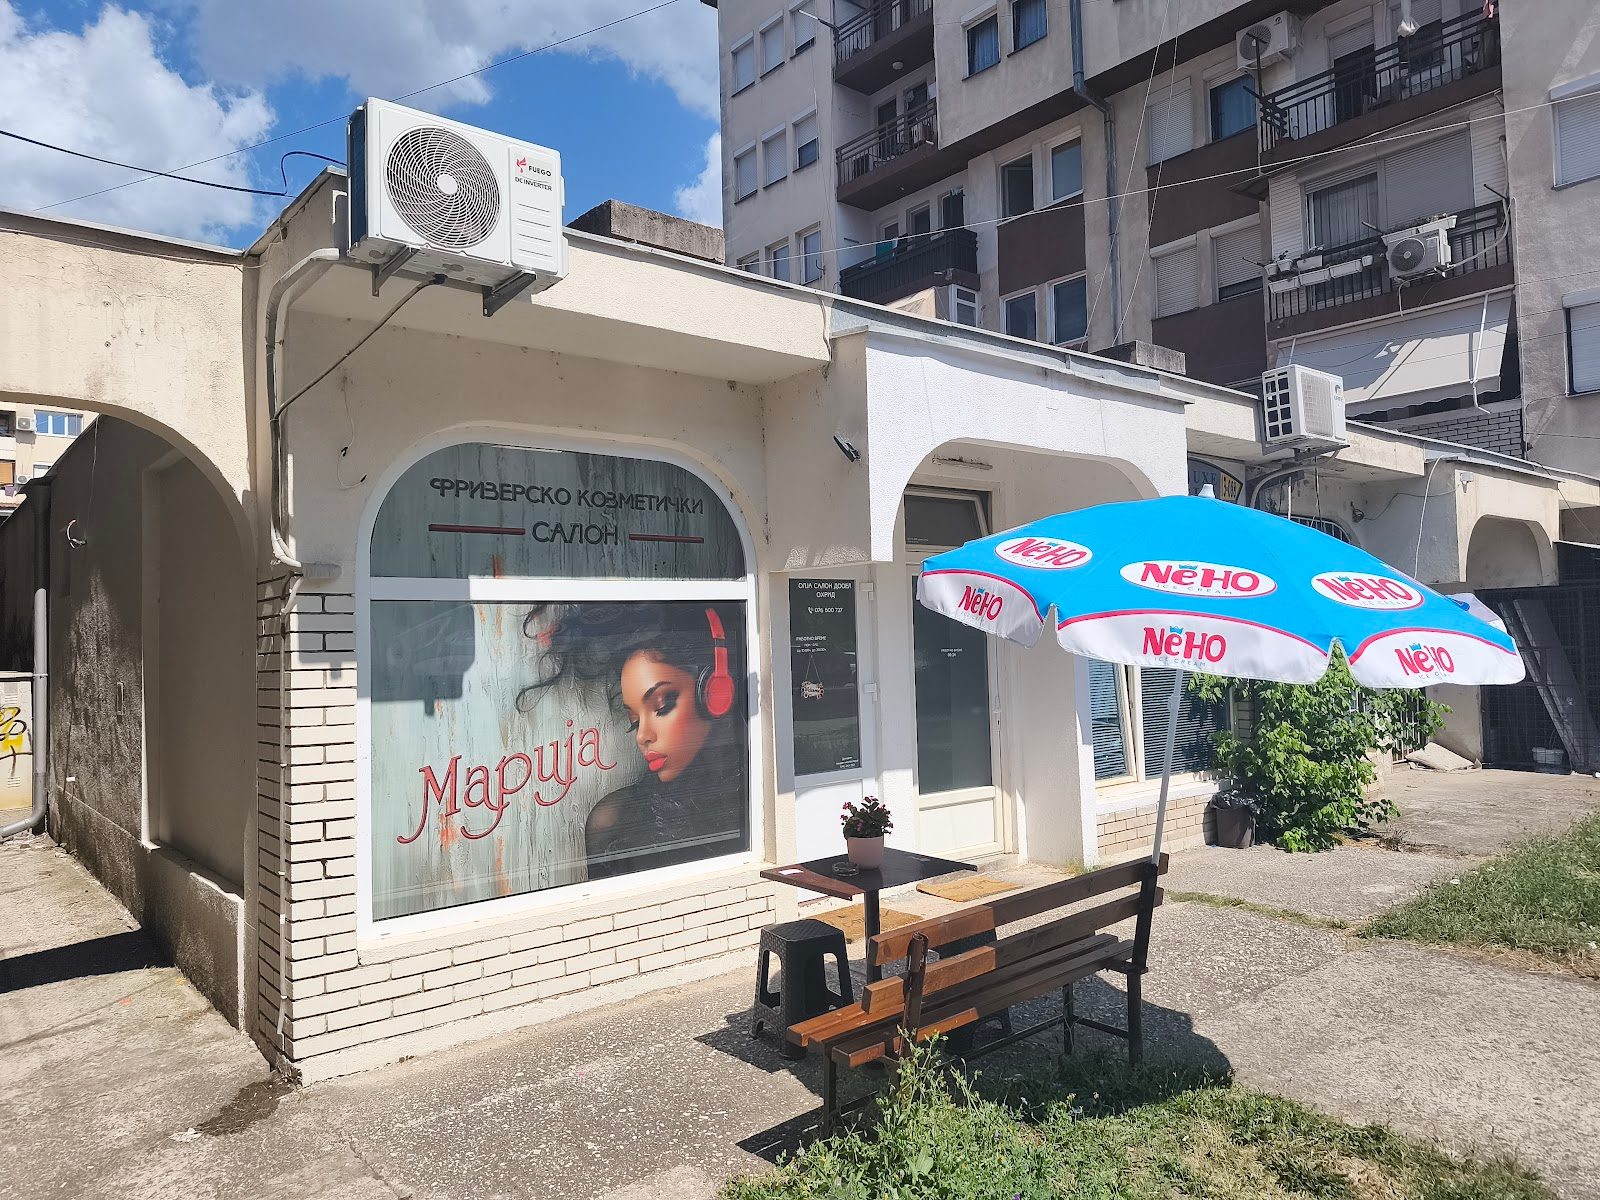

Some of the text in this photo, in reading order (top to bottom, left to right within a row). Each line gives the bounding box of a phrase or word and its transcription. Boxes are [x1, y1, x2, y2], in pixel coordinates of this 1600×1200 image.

[528, 165, 552, 176] FUEGO
[523, 179, 552, 191] INVERTER
[429, 477, 704, 515] ФРИЗЕРСКО КОЗМЕТИЧКИ
[531, 520, 619, 545] САЛОН
[1187, 586, 1233, 595] CREAM
[396, 719, 617, 844] Марија
